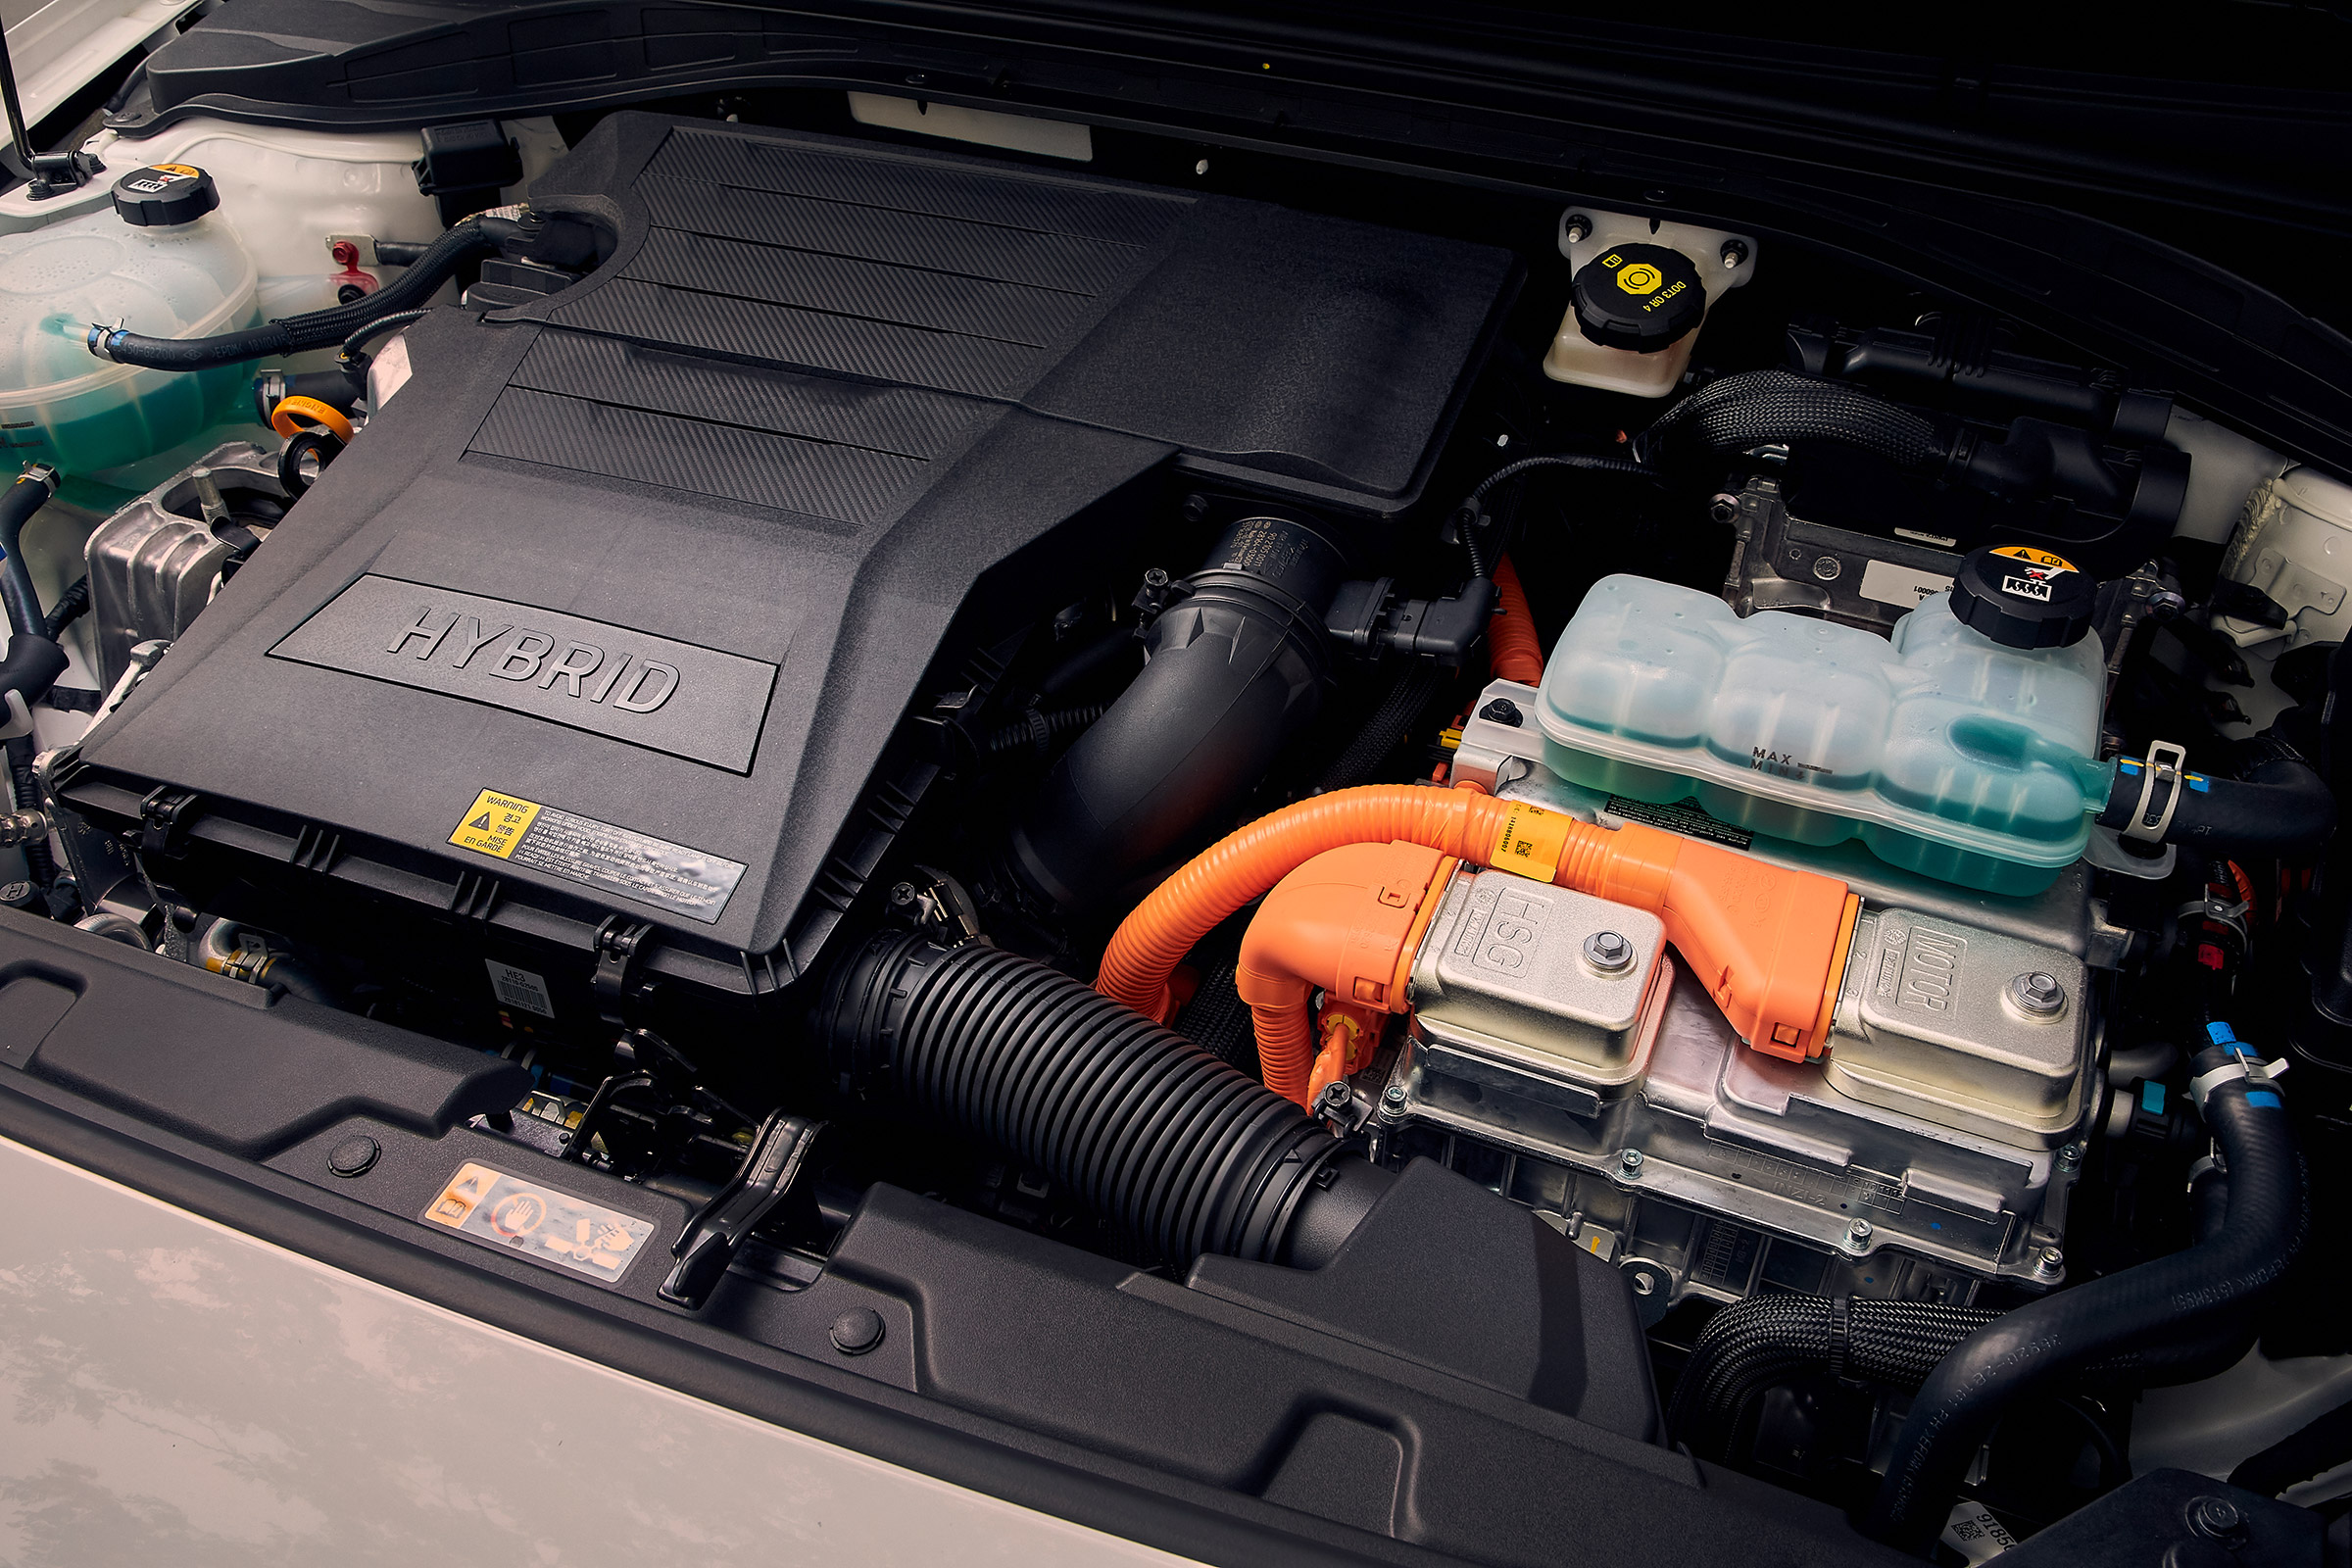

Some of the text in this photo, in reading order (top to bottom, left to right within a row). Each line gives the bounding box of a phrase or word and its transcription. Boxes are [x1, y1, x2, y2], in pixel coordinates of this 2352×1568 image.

[1662, 280, 1687, 299] DOT3
[1649, 295, 1665, 308] OR
[112, 342, 175, 361] 5450-G2700
[387, 606, 682, 715] HYBRID
[1751, 746, 1792, 765] MAX
[1749, 759, 1789, 777] MIN
[486, 796, 529, 813] WARNING
[503, 813, 522, 825] 경고
[496, 824, 514, 836] 警告
[476, 840, 503, 853] GARDE
[488, 835, 508, 846] MISE
[1487, 895, 1544, 968] HSG
[505, 968, 525, 982] HE3
[1904, 934, 1958, 1011] MOTOR
[1772, 1180, 1830, 1207] INZI-2
